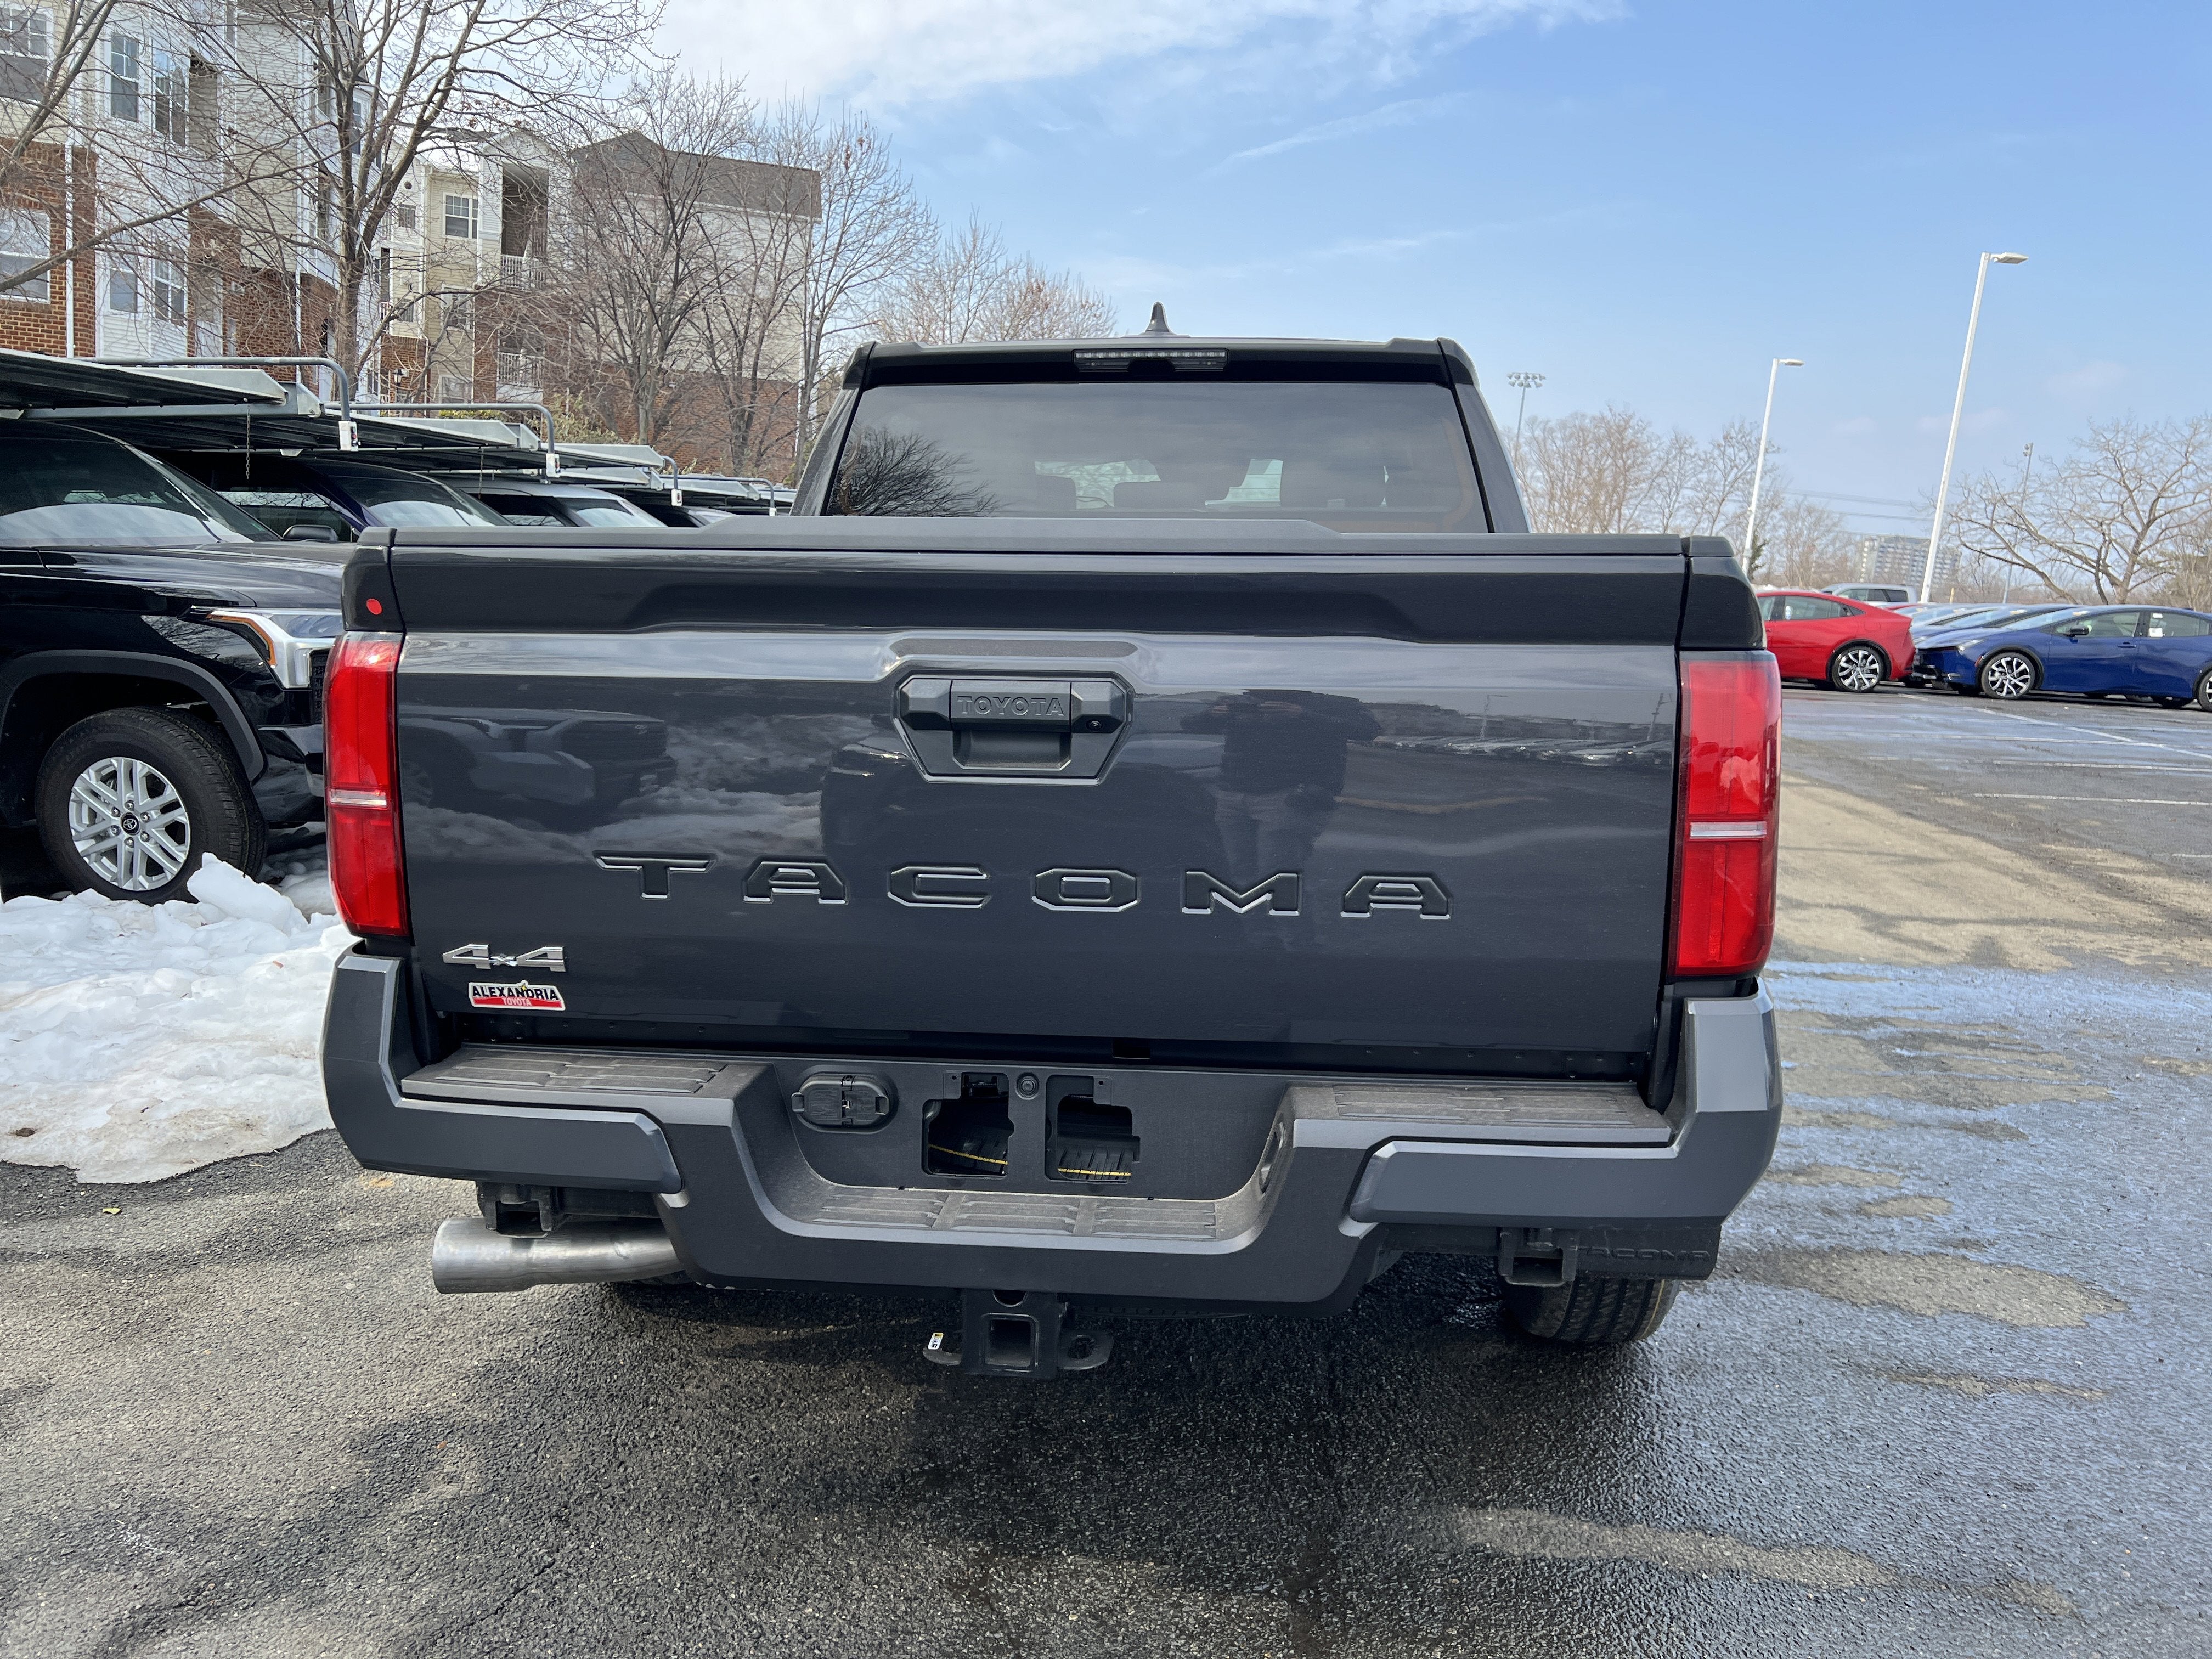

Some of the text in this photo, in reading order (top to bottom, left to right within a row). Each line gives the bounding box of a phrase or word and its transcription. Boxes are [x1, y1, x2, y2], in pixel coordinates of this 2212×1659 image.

[957, 695, 1065, 716] TOYOTA
[593, 850, 1452, 919] TACOMA
[473, 986, 559, 1001] ALEXANDRIA
[502, 997, 533, 1006] TOYOTA
